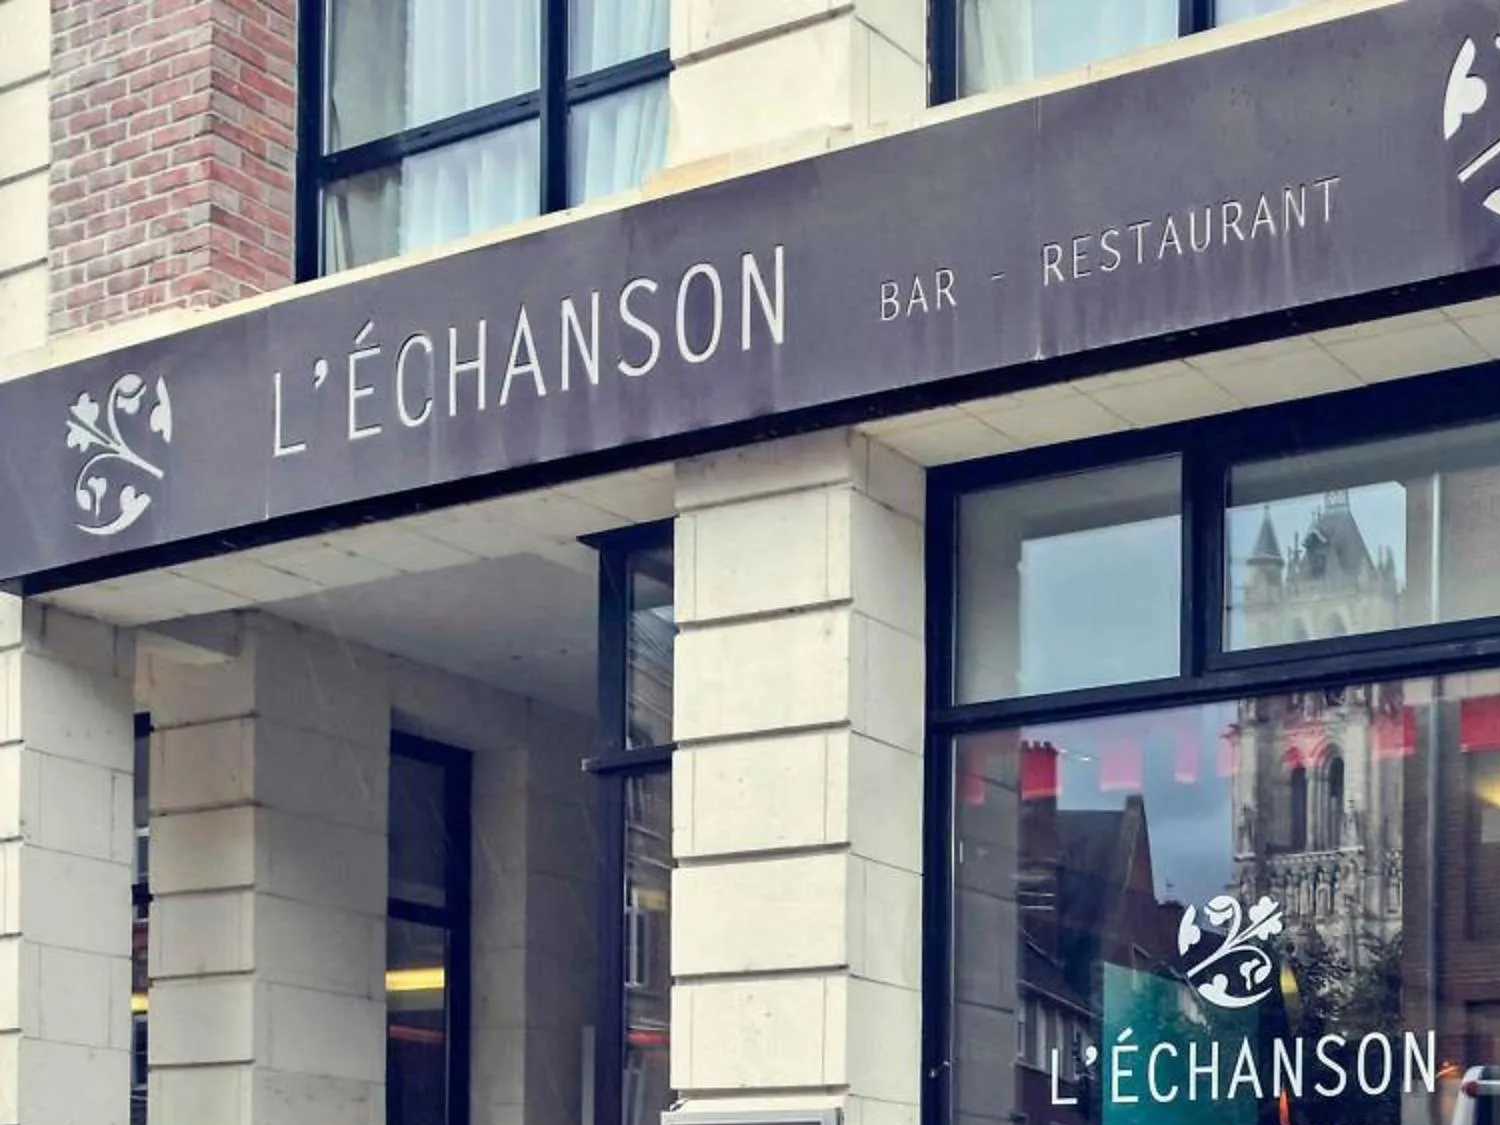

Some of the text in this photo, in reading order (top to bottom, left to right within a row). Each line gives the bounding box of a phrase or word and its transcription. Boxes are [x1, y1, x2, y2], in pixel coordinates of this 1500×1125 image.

[879, 268, 957, 321] BAR
[1042, 176, 1341, 287] RESTAURANT
[273, 244, 787, 457] L’ÉCHANSON
[1051, 1028, 1436, 1105] L’ÉCHANSON
